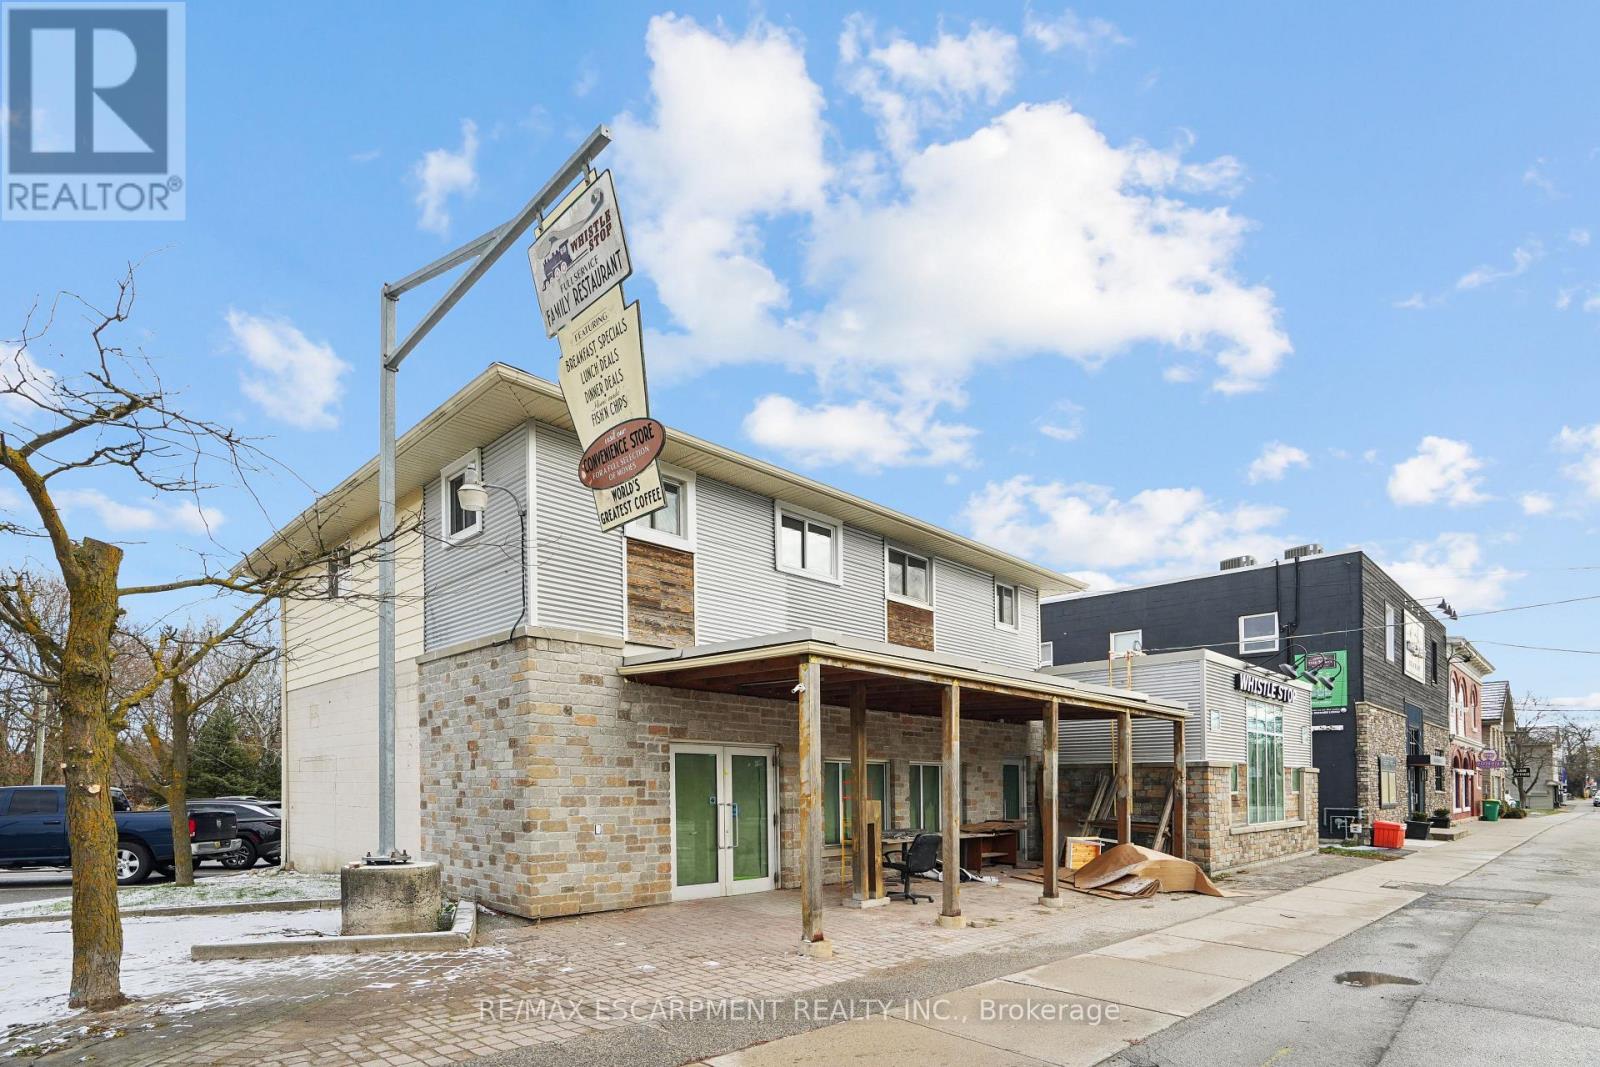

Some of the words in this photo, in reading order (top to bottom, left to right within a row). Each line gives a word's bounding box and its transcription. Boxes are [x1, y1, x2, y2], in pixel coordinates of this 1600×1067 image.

[570, 209, 612, 253] WHISTLE
[588, 222, 613, 253] STOP
[546, 295, 571, 327] FAMILY
[573, 249, 623, 304] RESTAURANT
[560, 276, 574, 293] FULL
[574, 255, 599, 281] SERVICE
[574, 312, 609, 342] FEATURING
[565, 340, 597, 372] BREAKFAST
[598, 318, 628, 349] SPECIALS
[580, 361, 600, 384] LUNCH
[600, 348, 620, 370] DEALS
[585, 381, 605, 404] DINNER
[604, 369, 624, 391] DEALS
[610, 395, 628, 416] CHIPS
[583, 438, 629, 473] CONVENIENCE
[630, 422, 655, 449] STORE
[620, 446, 651, 466] SELECTION
[608, 472, 617, 481] OF
[611, 478, 641, 502] WORLD'S
[600, 500, 632, 525] GREATEST
[634, 487, 662, 509] COFFEE
[1239, 672, 1277, 699] WHISTLE
